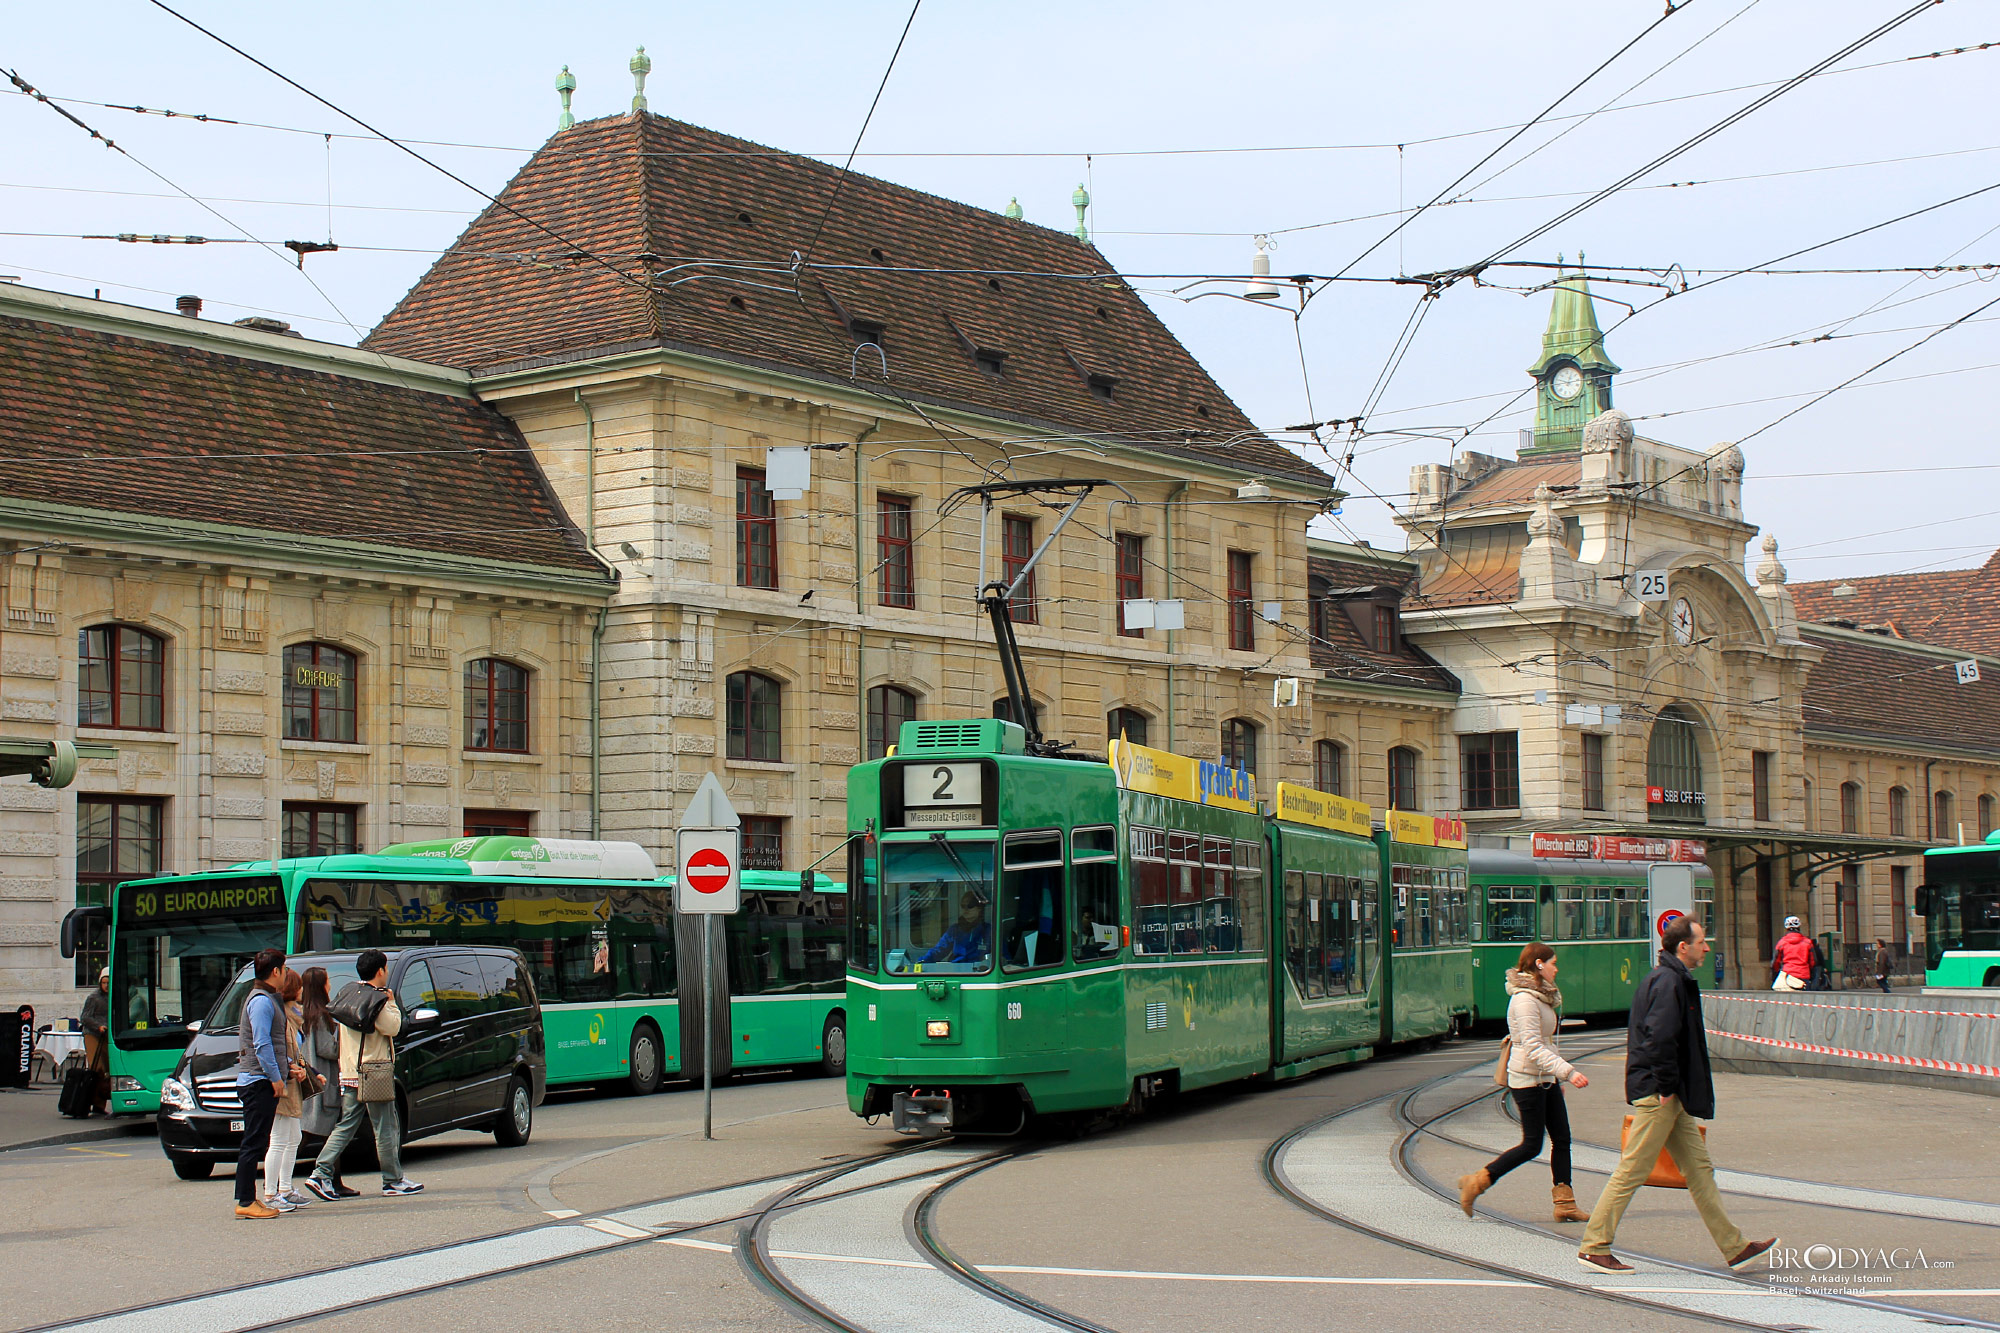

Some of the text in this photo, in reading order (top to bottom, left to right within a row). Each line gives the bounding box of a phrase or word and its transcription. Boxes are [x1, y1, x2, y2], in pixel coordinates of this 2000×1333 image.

[1641, 576, 1665, 595] 25
[1961, 664, 1977, 678] 45
[932, 766, 954, 800] 2
[1199, 754, 1249, 805] grafe.ch
[1664, 789, 1707, 805] SBB CFF FFS
[910, 811, 977, 823] Messeplatz-Eglisee
[1327, 800, 1347, 822] Schilder
[1534, 837, 1564, 851] Witercho
[1564, 838, 1576, 852] mit
[511, 848, 533, 860] erdgas
[135, 886, 278, 917] 50 EUROAIRPORT
[1007, 1002, 1022, 1019] 660
[20, 1024, 31, 1073] CALANDA
[232, 1122, 241, 1130] BS
